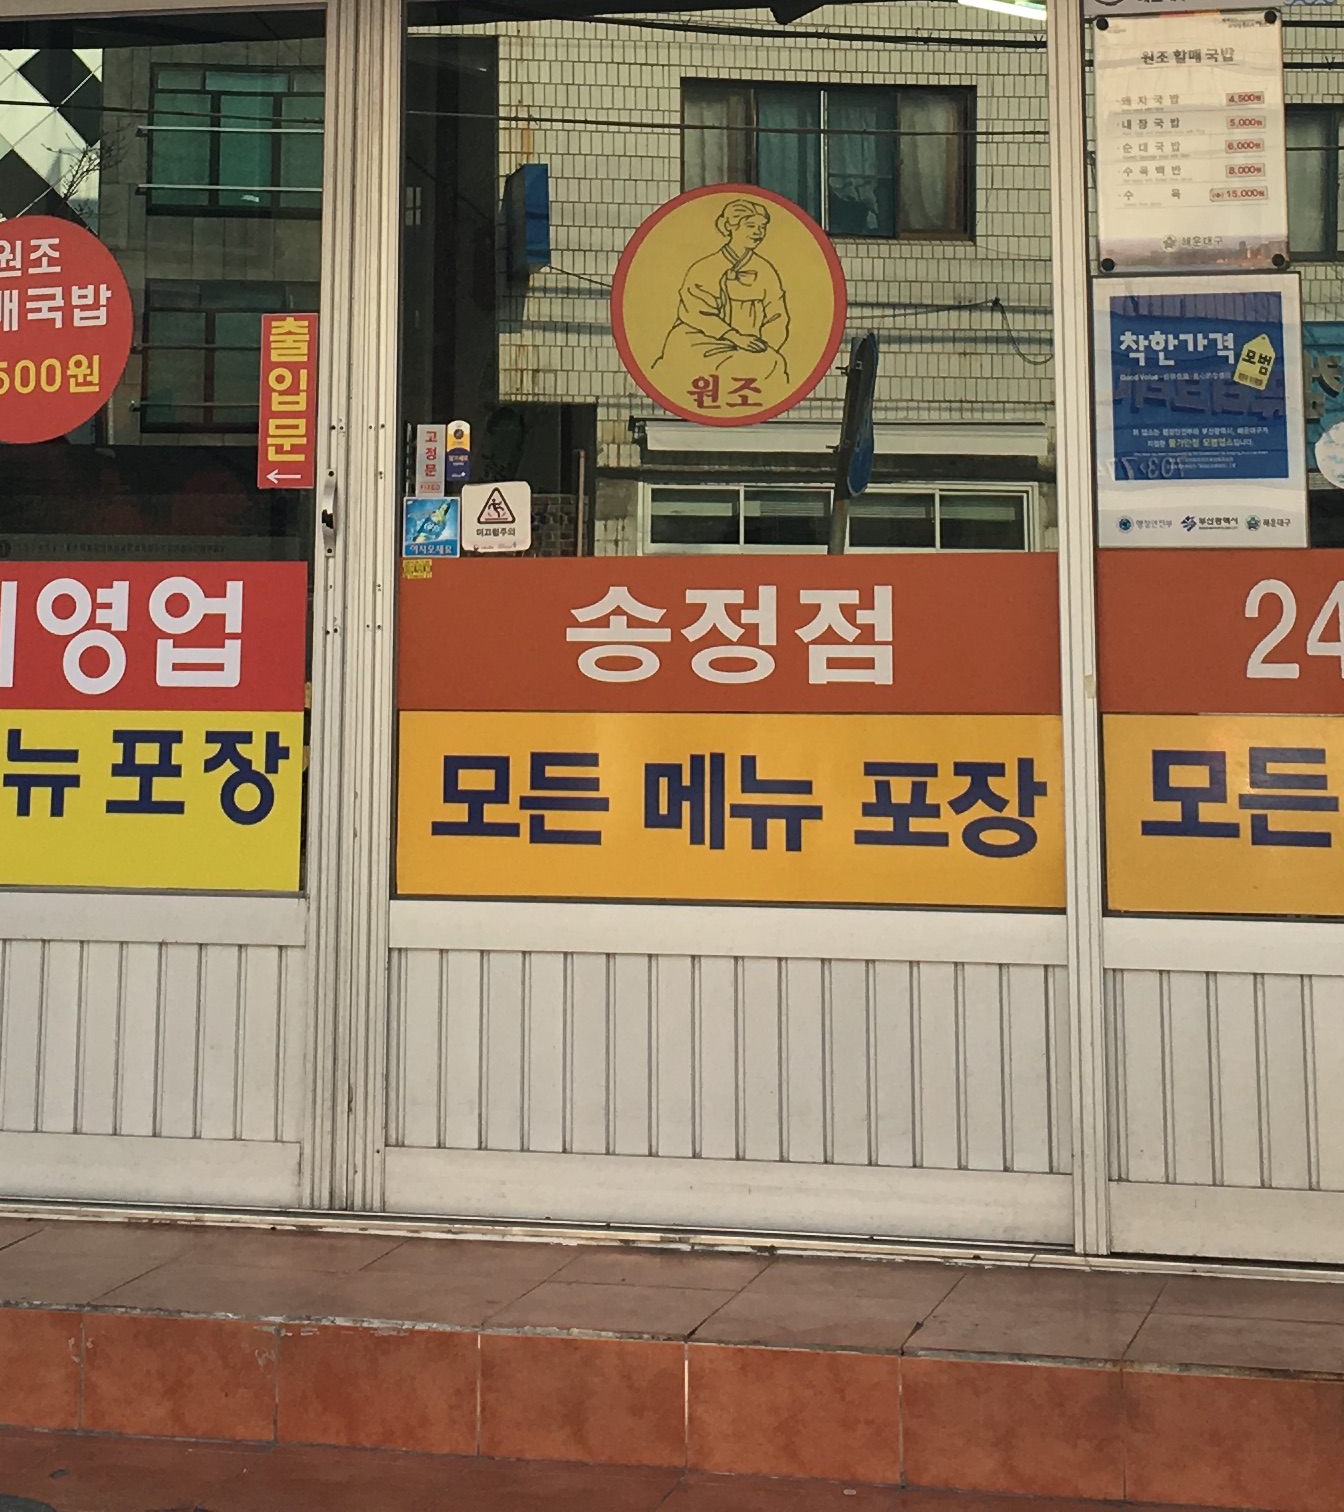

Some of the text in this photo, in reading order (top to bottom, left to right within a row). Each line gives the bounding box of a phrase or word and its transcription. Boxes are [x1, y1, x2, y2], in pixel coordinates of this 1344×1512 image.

[1122, 118, 1180, 130] 내장국밥
[1123, 141, 1180, 153] 순대국밥
[1181, 236, 1223, 248] 해운대구
[1119, 330, 1235, 366] 착한가격
[1242, 349, 1272, 376] 모범
[265, 317, 311, 463] 출입문
[686, 373, 763, 411] 원조
[424, 430, 438, 478] 고정문
[476, 527, 516, 537] 미끄럼주의
[1199, 517, 1239, 526] 부산광역시
[1263, 518, 1292, 528] 해운대구
[565, 585, 894, 686] 송정점
[105, 729, 291, 826] 포장
[430, 751, 1048, 858] 모든 메뉴 포장
[1141, 746, 1339, 848] 모든
